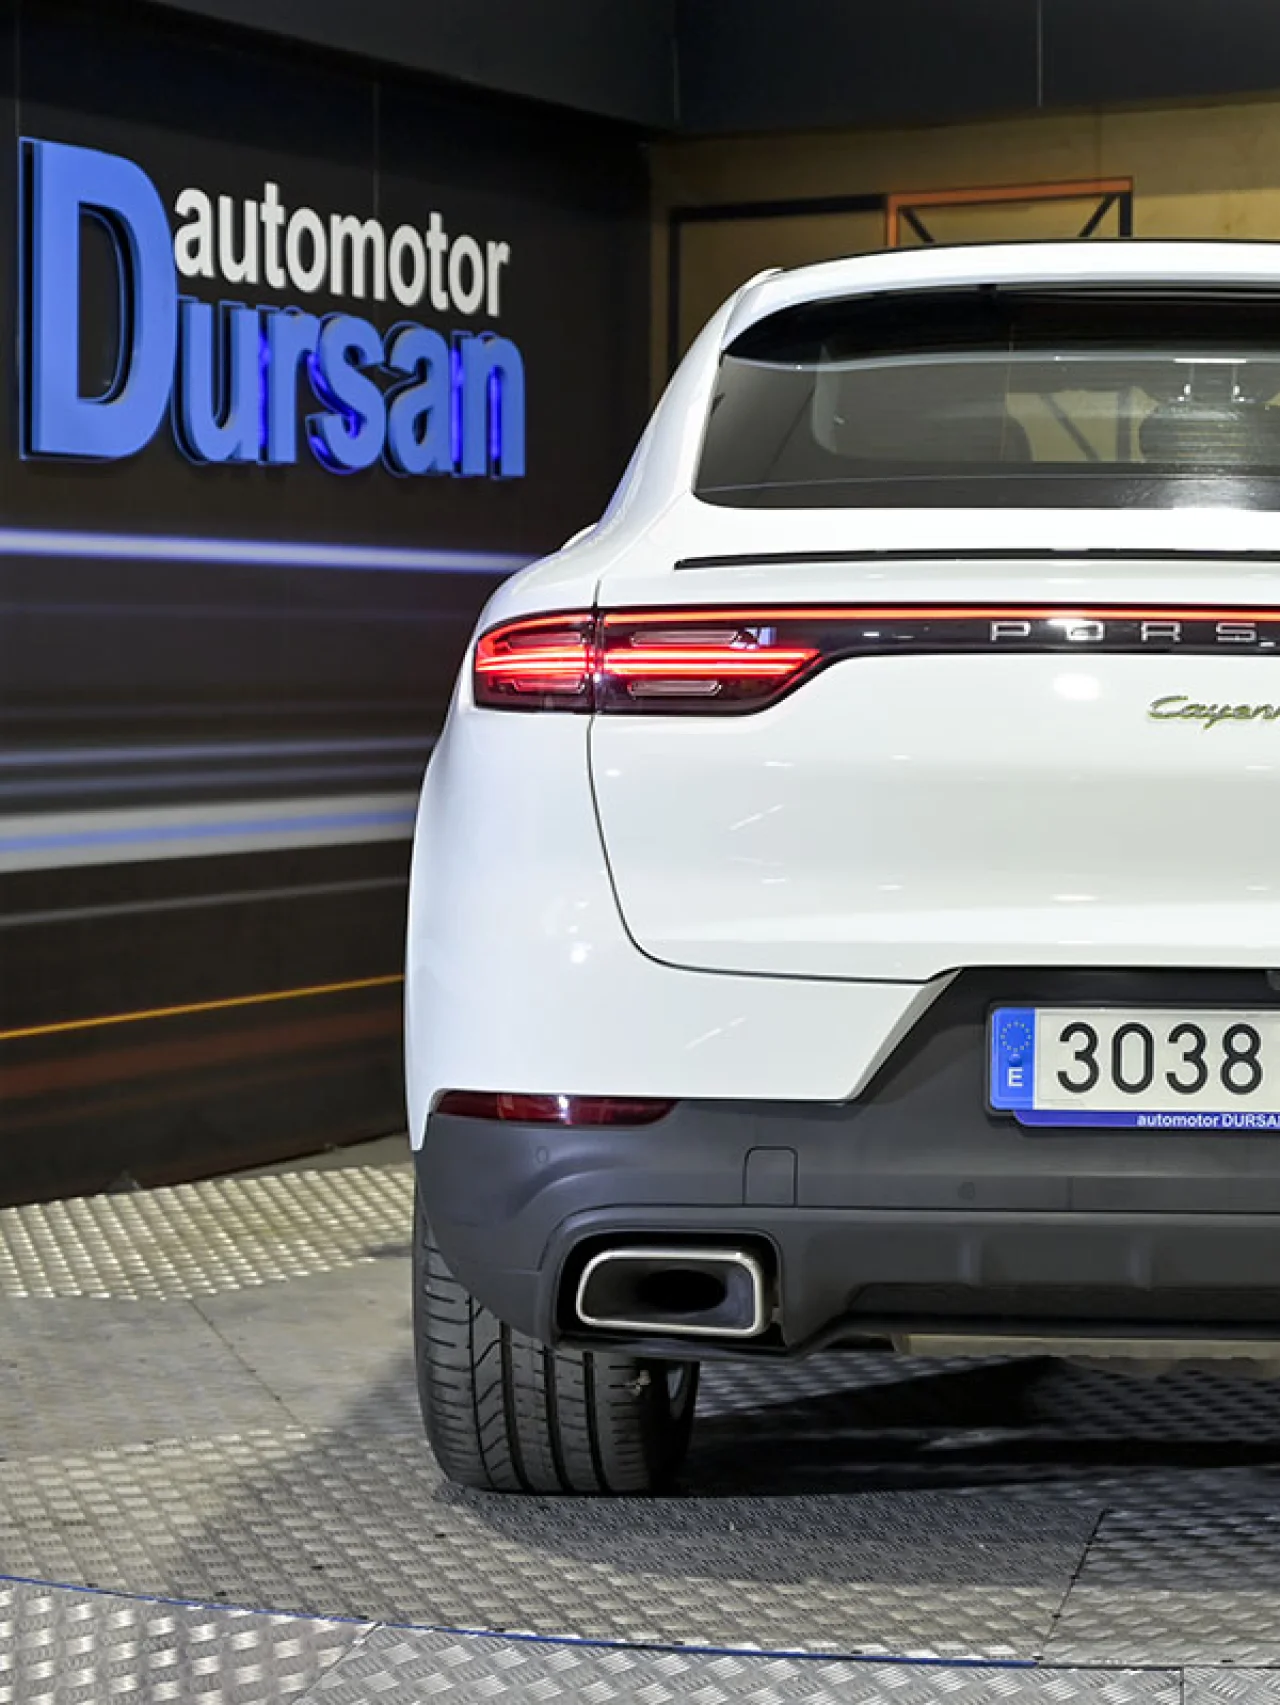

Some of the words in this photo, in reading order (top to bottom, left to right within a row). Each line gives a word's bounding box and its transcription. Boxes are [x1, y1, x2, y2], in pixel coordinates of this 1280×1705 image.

[173, 182, 510, 317] automotor
[19, 136, 525, 478] Dursan
[1008, 1068, 1023, 1087] E
[1057, 1021, 1263, 1096] 3038
